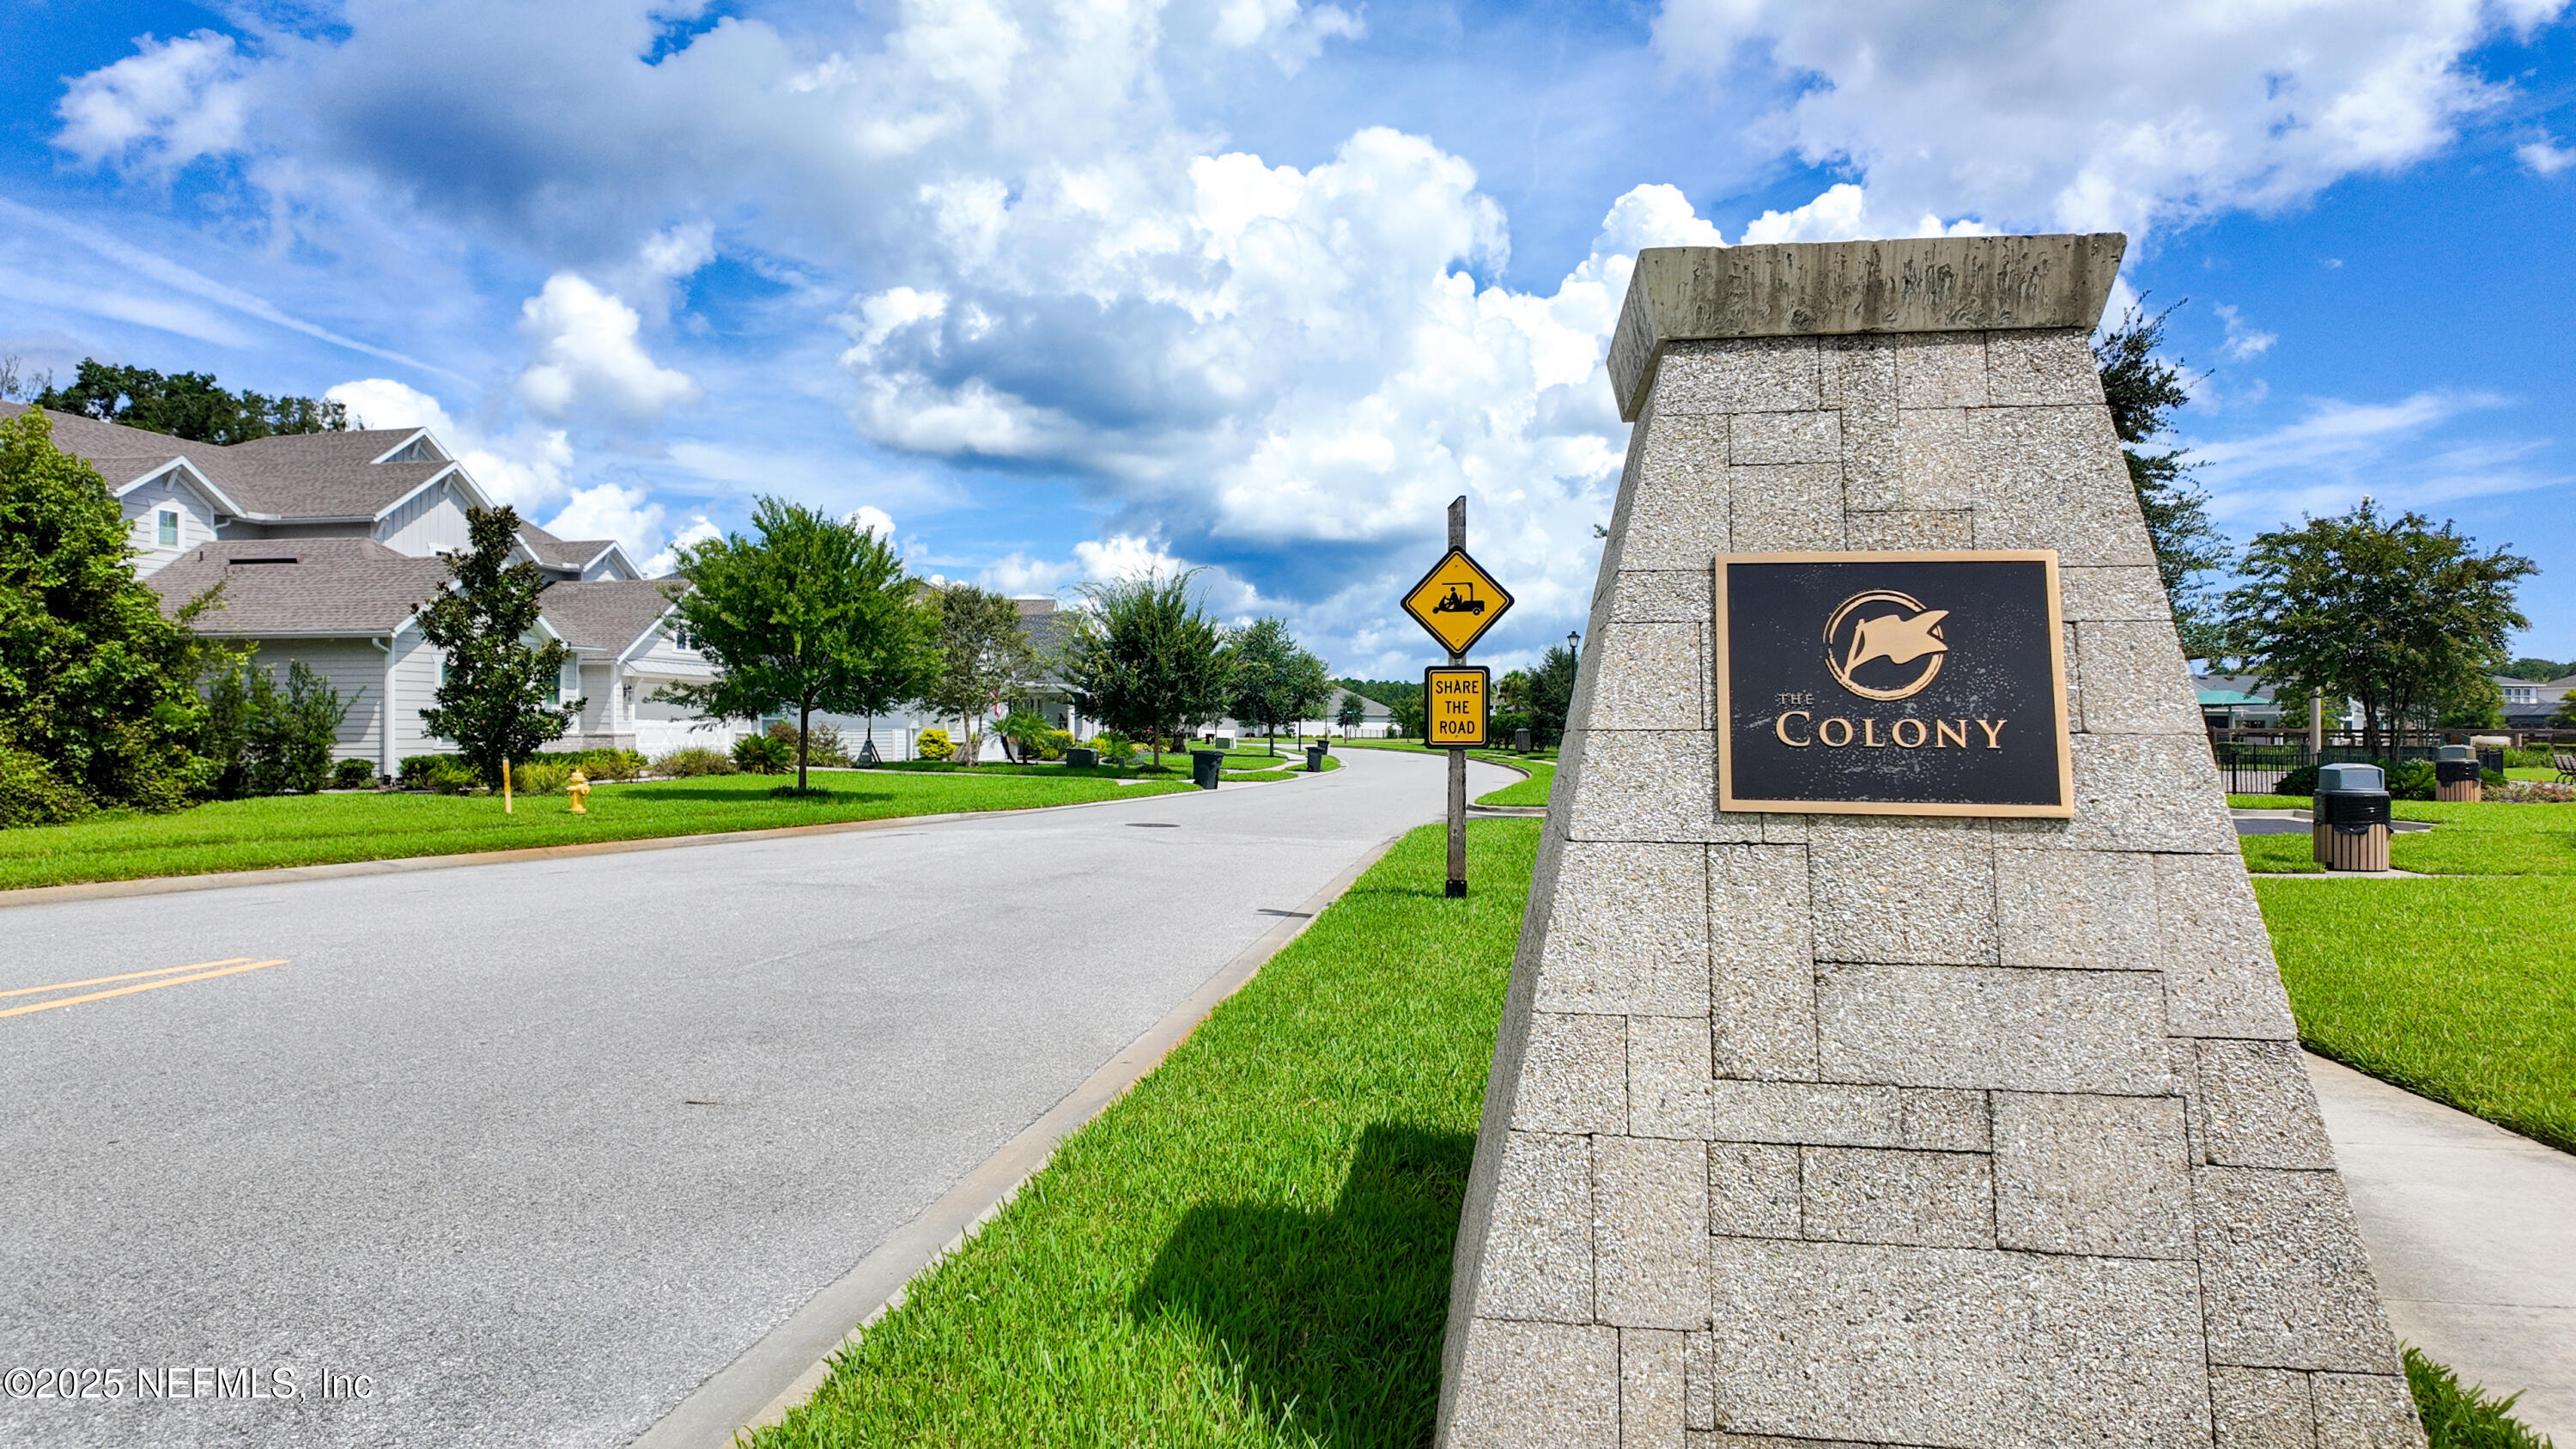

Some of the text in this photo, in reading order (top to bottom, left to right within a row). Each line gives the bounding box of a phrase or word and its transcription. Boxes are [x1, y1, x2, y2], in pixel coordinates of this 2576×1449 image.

[1436, 680, 1479, 694] SHARE
[1778, 693, 1814, 705] THE
[1445, 701, 1469, 714] THE
[1440, 721, 1475, 734] ROAD
[1775, 710, 2008, 749] COLONY
